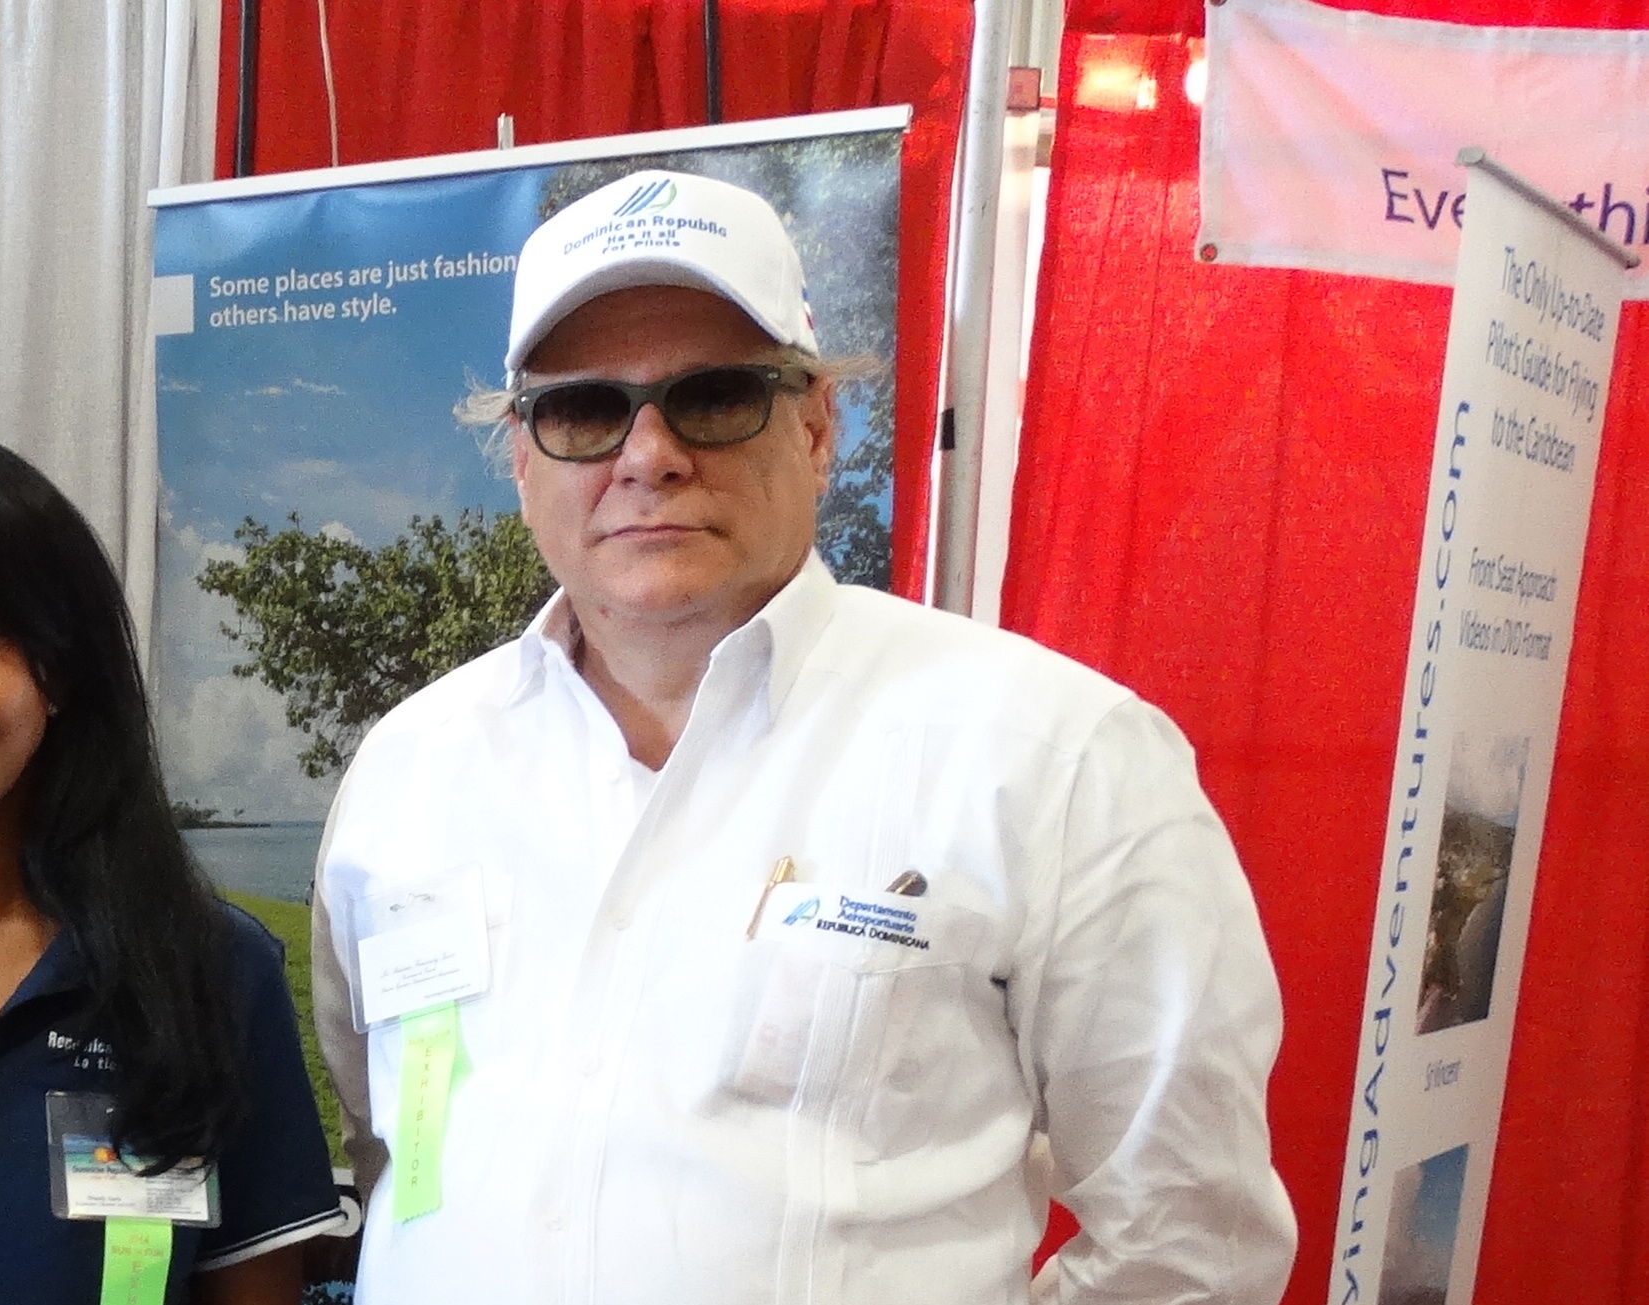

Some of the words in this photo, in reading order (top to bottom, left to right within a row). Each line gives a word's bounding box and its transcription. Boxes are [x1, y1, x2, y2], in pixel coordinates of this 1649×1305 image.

[564, 215, 647, 255] Dominican
[653, 215, 727, 238] Republic
[209, 275, 269, 299] Some
[275, 269, 343, 299] places
[349, 265, 382, 286] are
[385, 259, 428, 288] just
[1502, 246, 1523, 299] The
[1524, 260, 1550, 324] Only
[209, 302, 278, 329] others
[284, 298, 335, 322] have
[341, 292, 397, 323] style.
[1486, 319, 1521, 377] Pilot's
[1522, 338, 1551, 392] Guide
[1552, 352, 1569, 396] for
[1567, 360, 1598, 424] Flying
[1491, 406, 1505, 448] to
[1505, 408, 1524, 455] the
[1526, 414, 1576, 474] Caribbean
